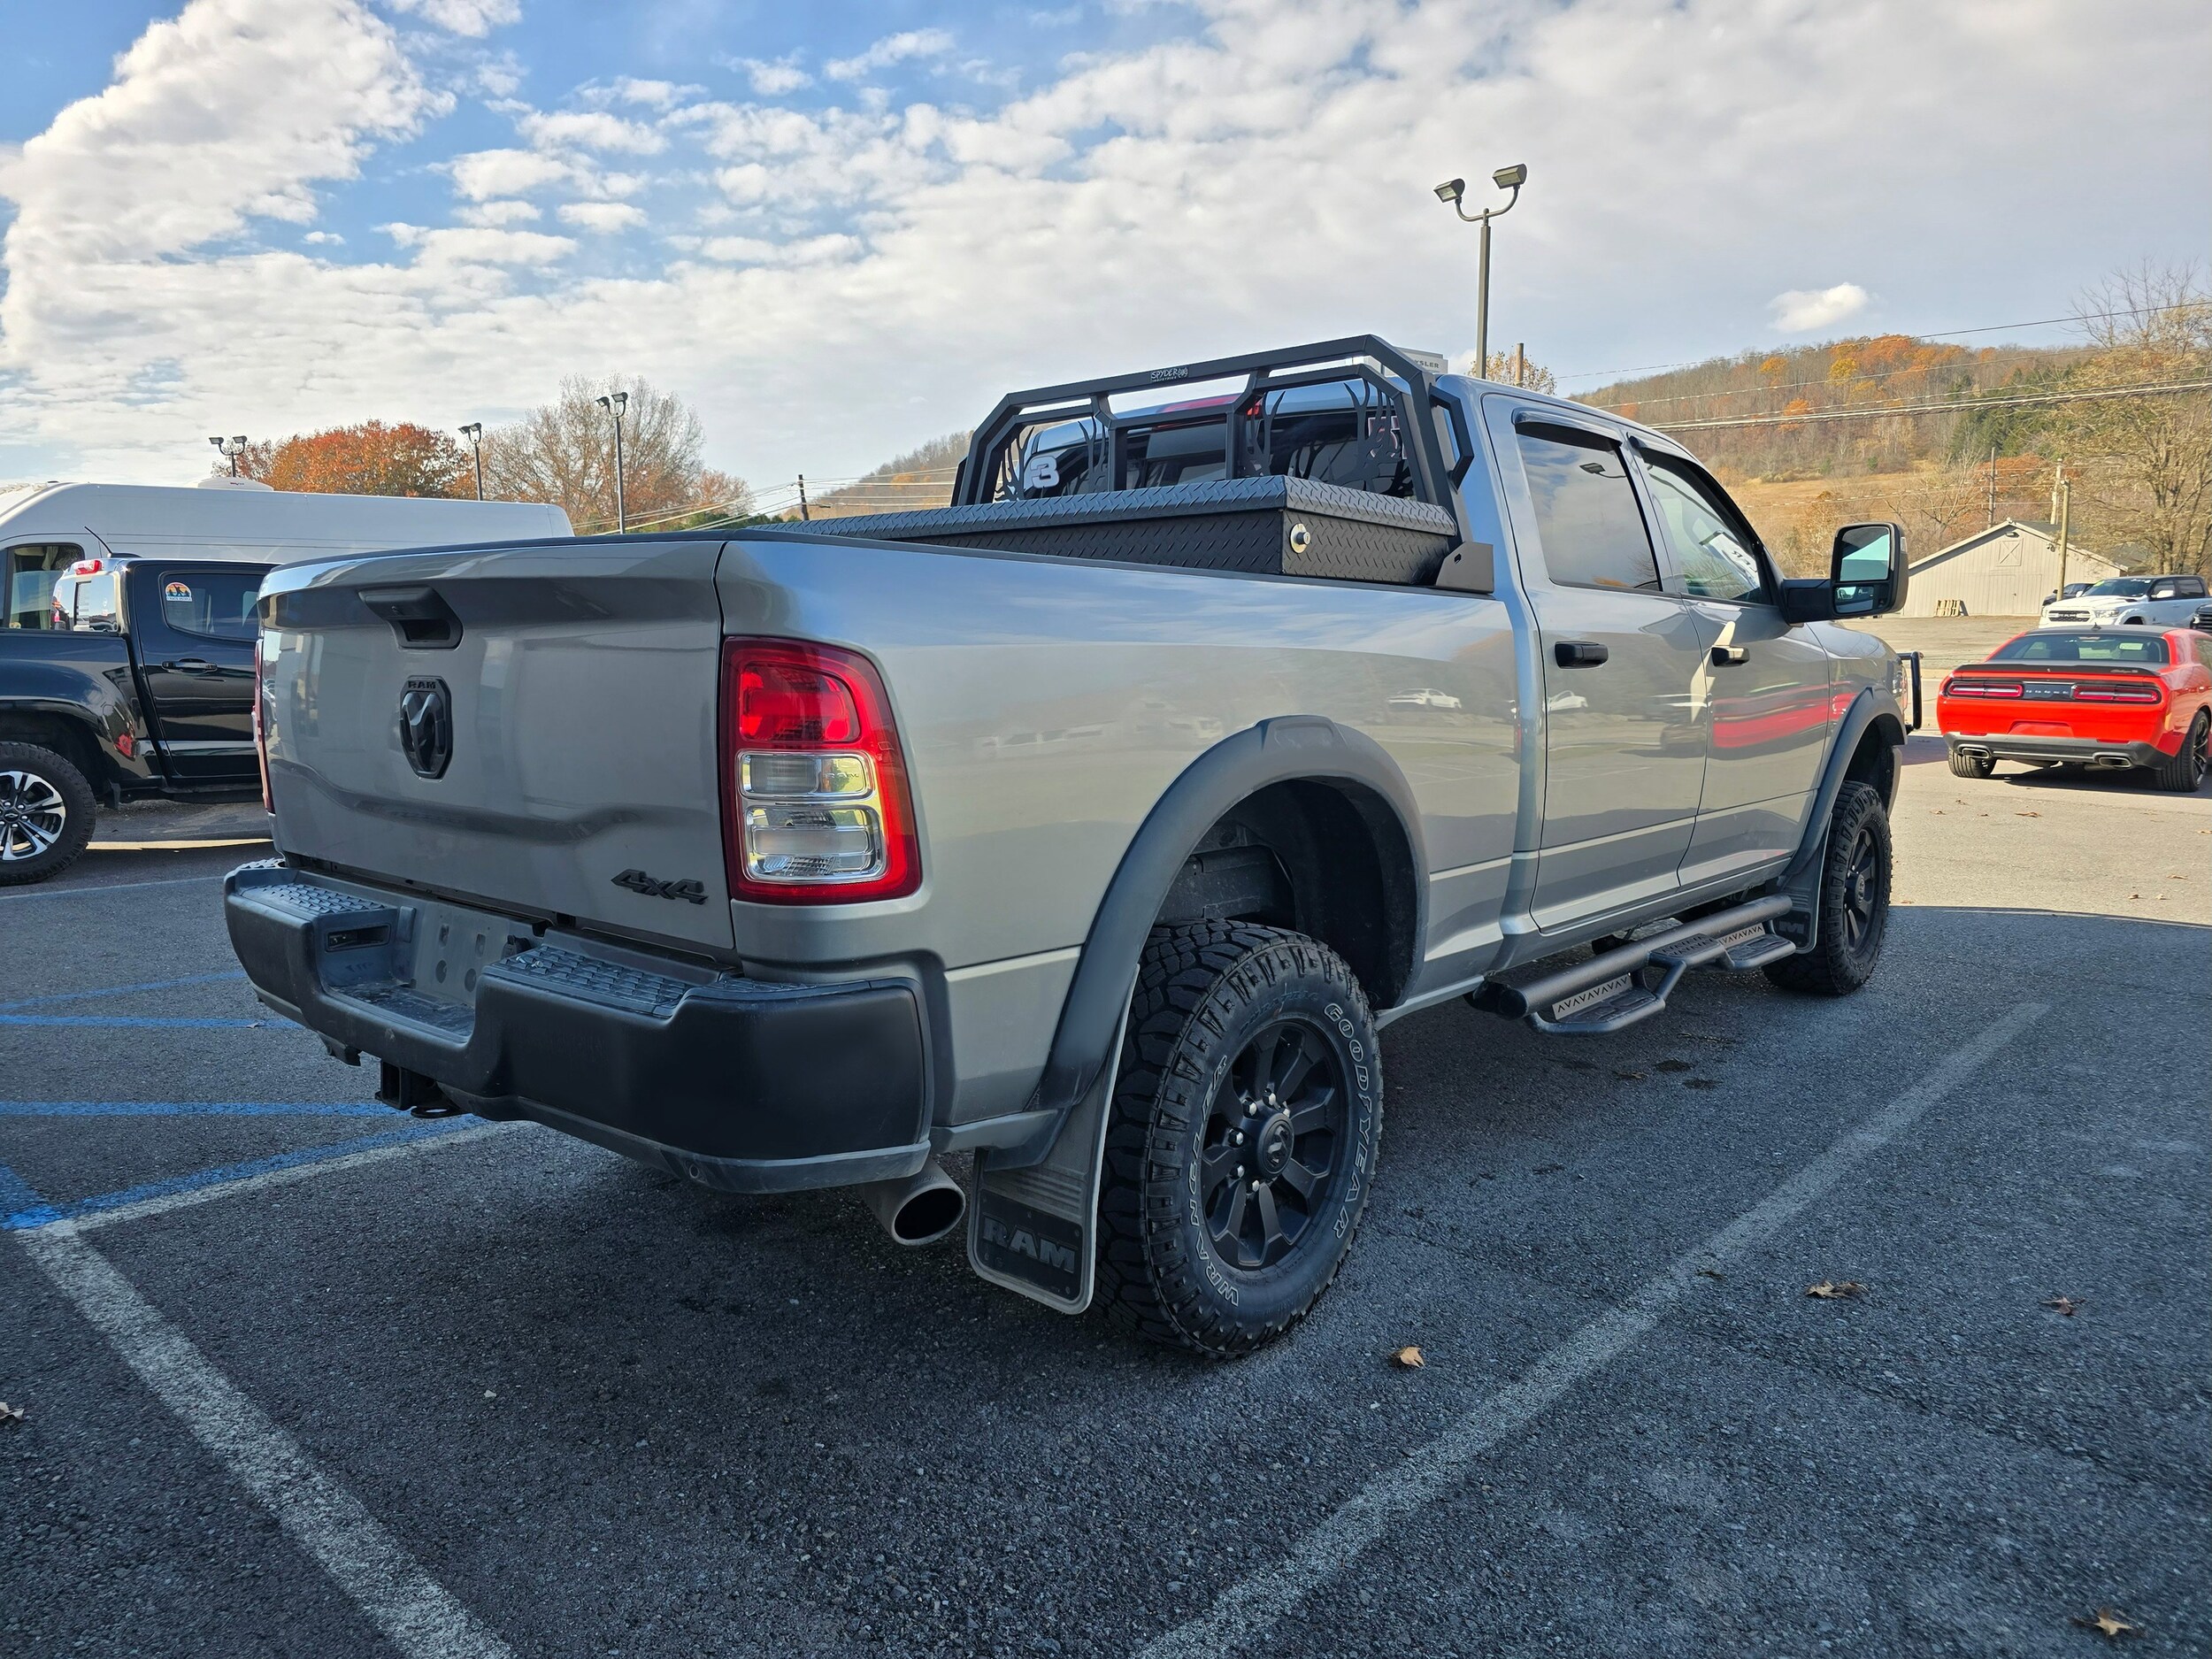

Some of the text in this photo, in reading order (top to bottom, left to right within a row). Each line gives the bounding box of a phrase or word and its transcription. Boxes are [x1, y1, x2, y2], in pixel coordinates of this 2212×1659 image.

[1150, 367, 1178, 380] SPYDER
[1414, 359, 1440, 369] YSLER
[1029, 455, 1060, 489] 3
[408, 680, 436, 689] RAM
[1324, 1002, 1372, 1240] GOODYEAR
[982, 1215, 1077, 1274] RAM
